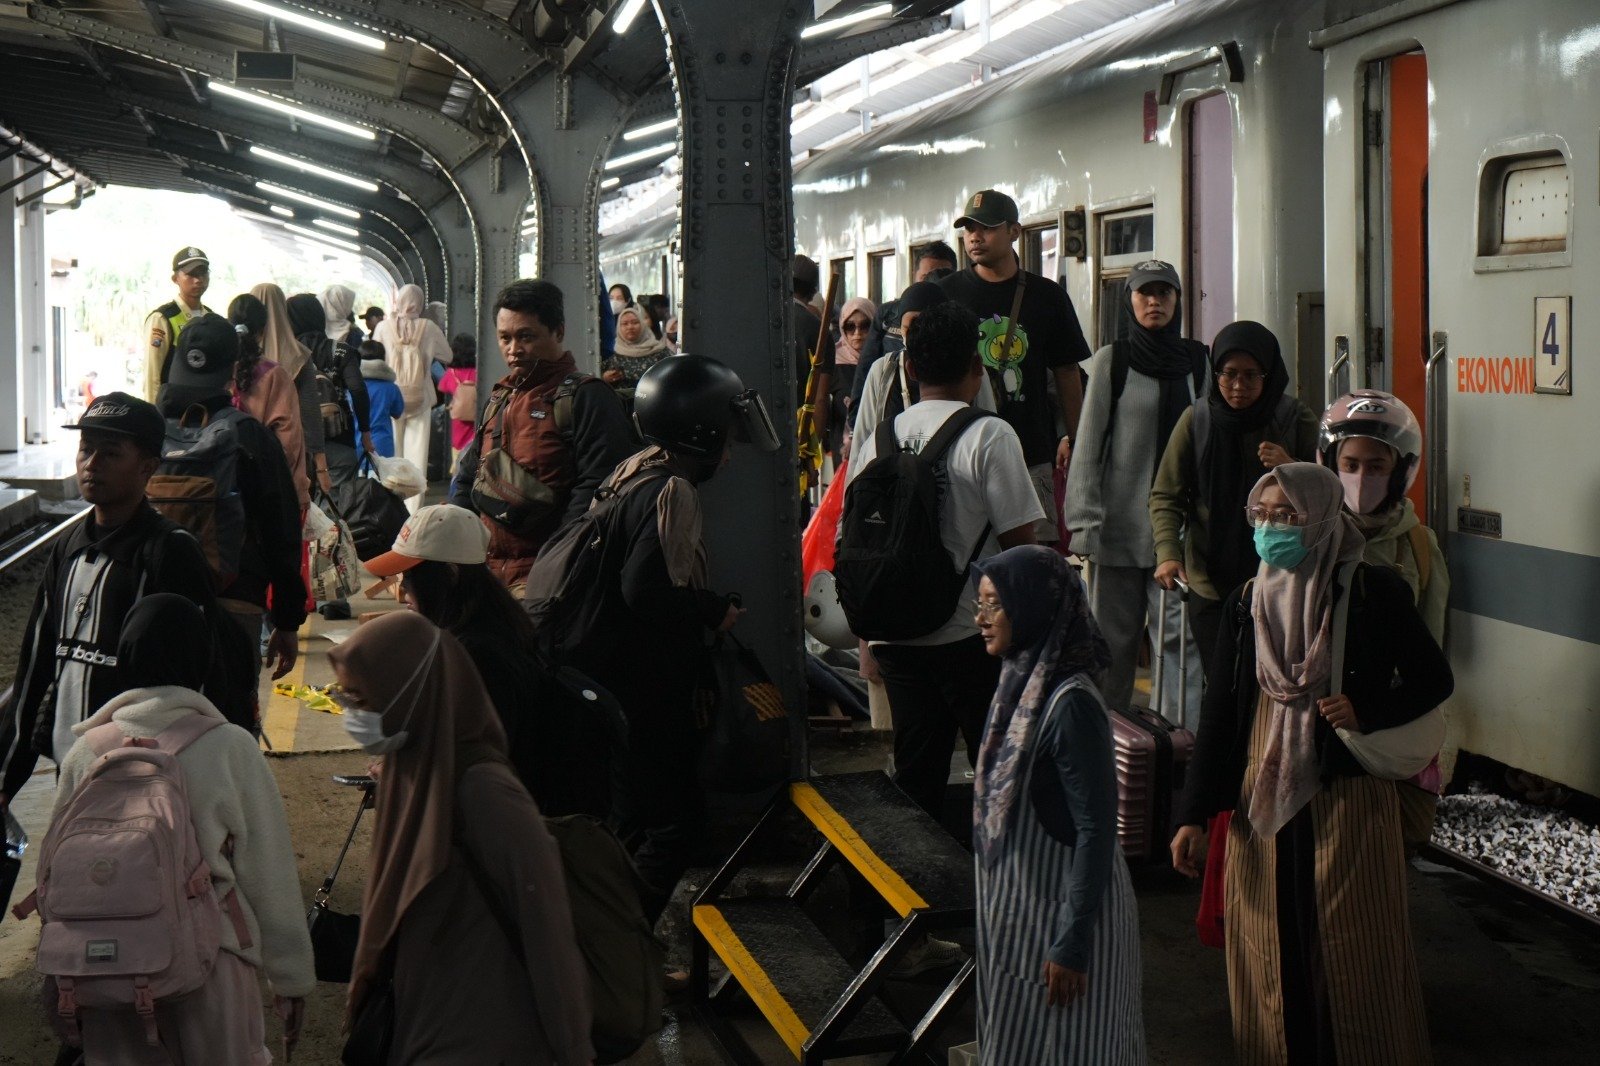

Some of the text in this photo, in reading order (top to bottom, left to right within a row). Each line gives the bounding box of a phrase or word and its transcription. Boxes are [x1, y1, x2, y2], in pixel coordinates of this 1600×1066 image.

[1542, 312, 1560, 366] 4
[1457, 357, 1534, 395] EKONOMI
[72, 644, 117, 666] bobs
